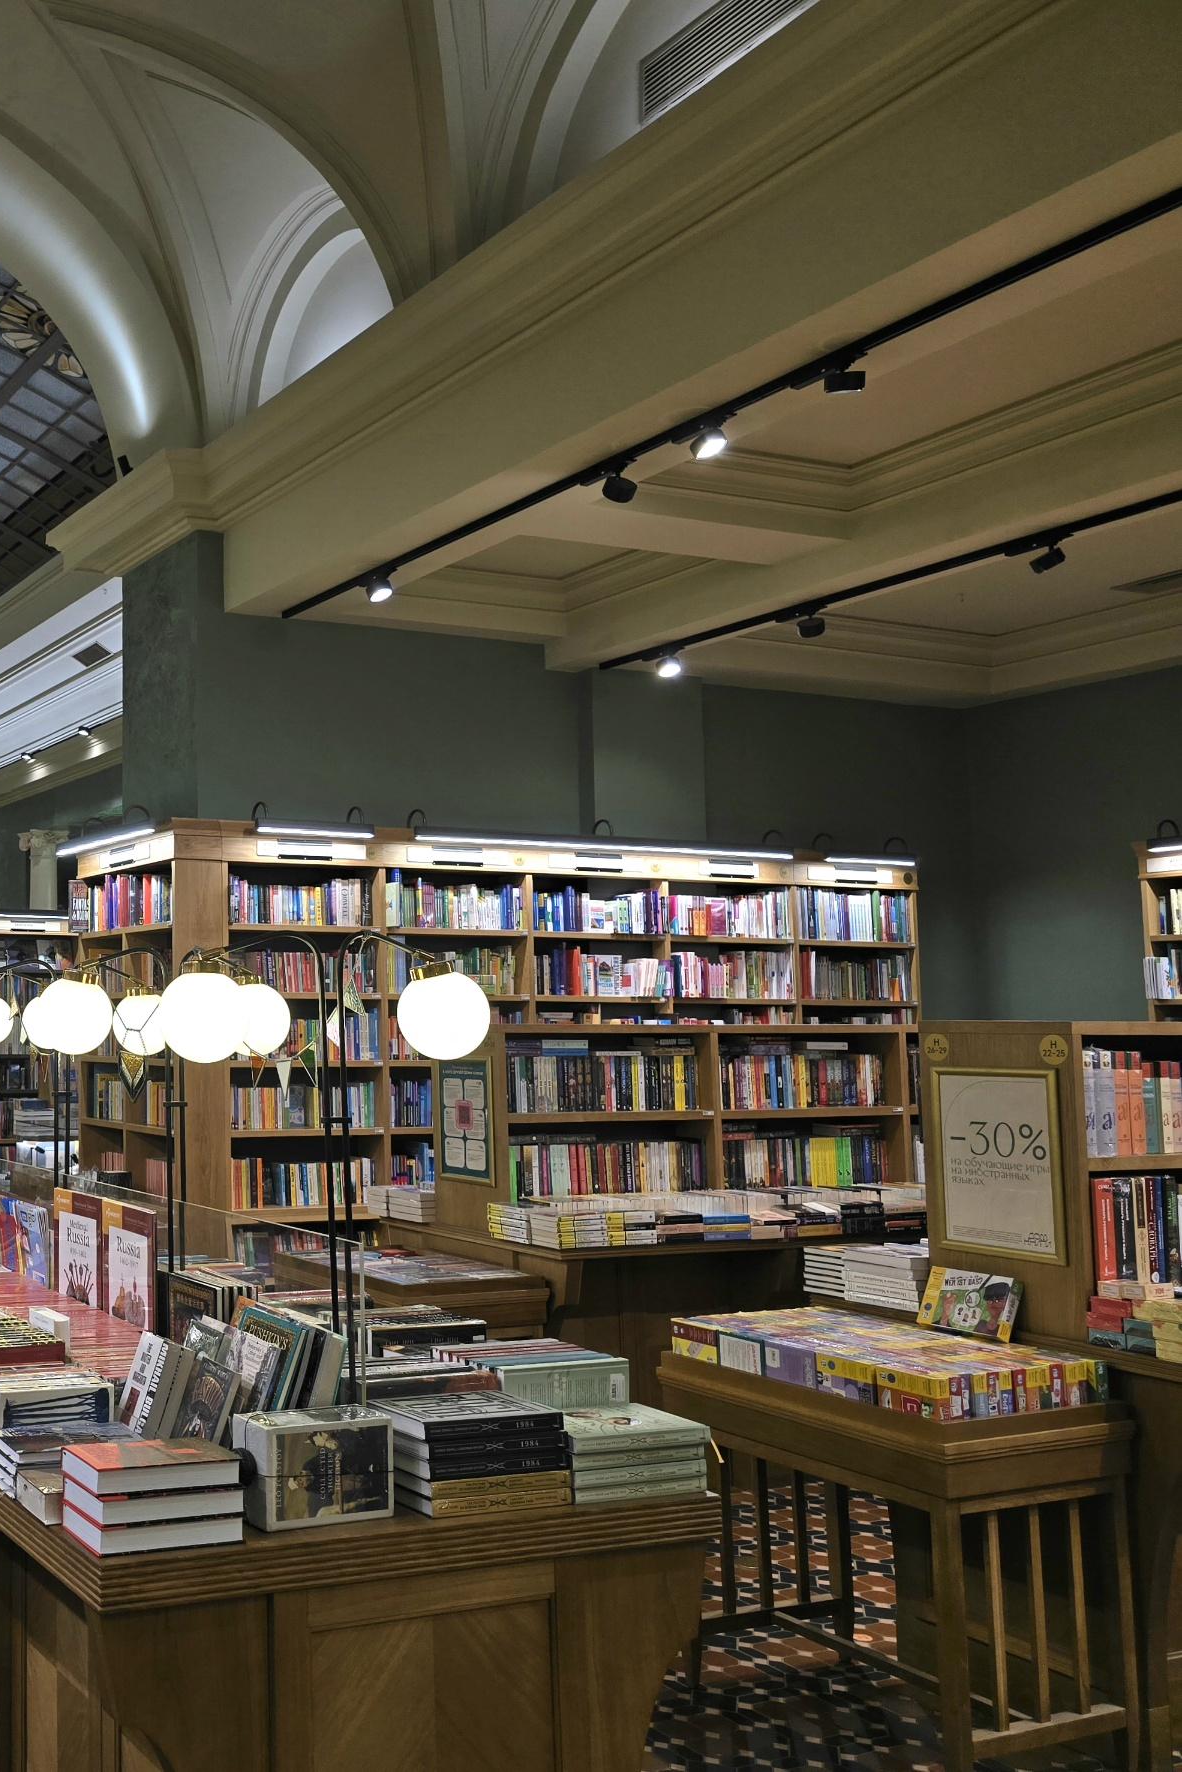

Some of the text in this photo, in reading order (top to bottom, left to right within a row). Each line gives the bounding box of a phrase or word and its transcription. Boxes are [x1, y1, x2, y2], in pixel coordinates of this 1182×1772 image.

[1042, 1049, 1066, 1058] 22-25
[949, 1121, 1047, 1161] -30%
[950, 1157, 1050, 1177] на обучающие игры
[951, 1167, 1030, 1181] на иностранных
[951, 1176, 985, 1186] языках
[66, 1227, 90, 1248] Russia
[116, 1236, 141, 1259] Russia
[956, 1278, 966, 1286] IST
[248, 1323, 289, 1350] PUSHKIN'S
[148, 1342, 169, 1393] MIKHAIL
[134, 1395, 154, 1435] BULGA
[515, 1421, 535, 1429] 1984
[520, 1439, 539, 1448] 1984
[521, 1459, 541, 1467] 1984
